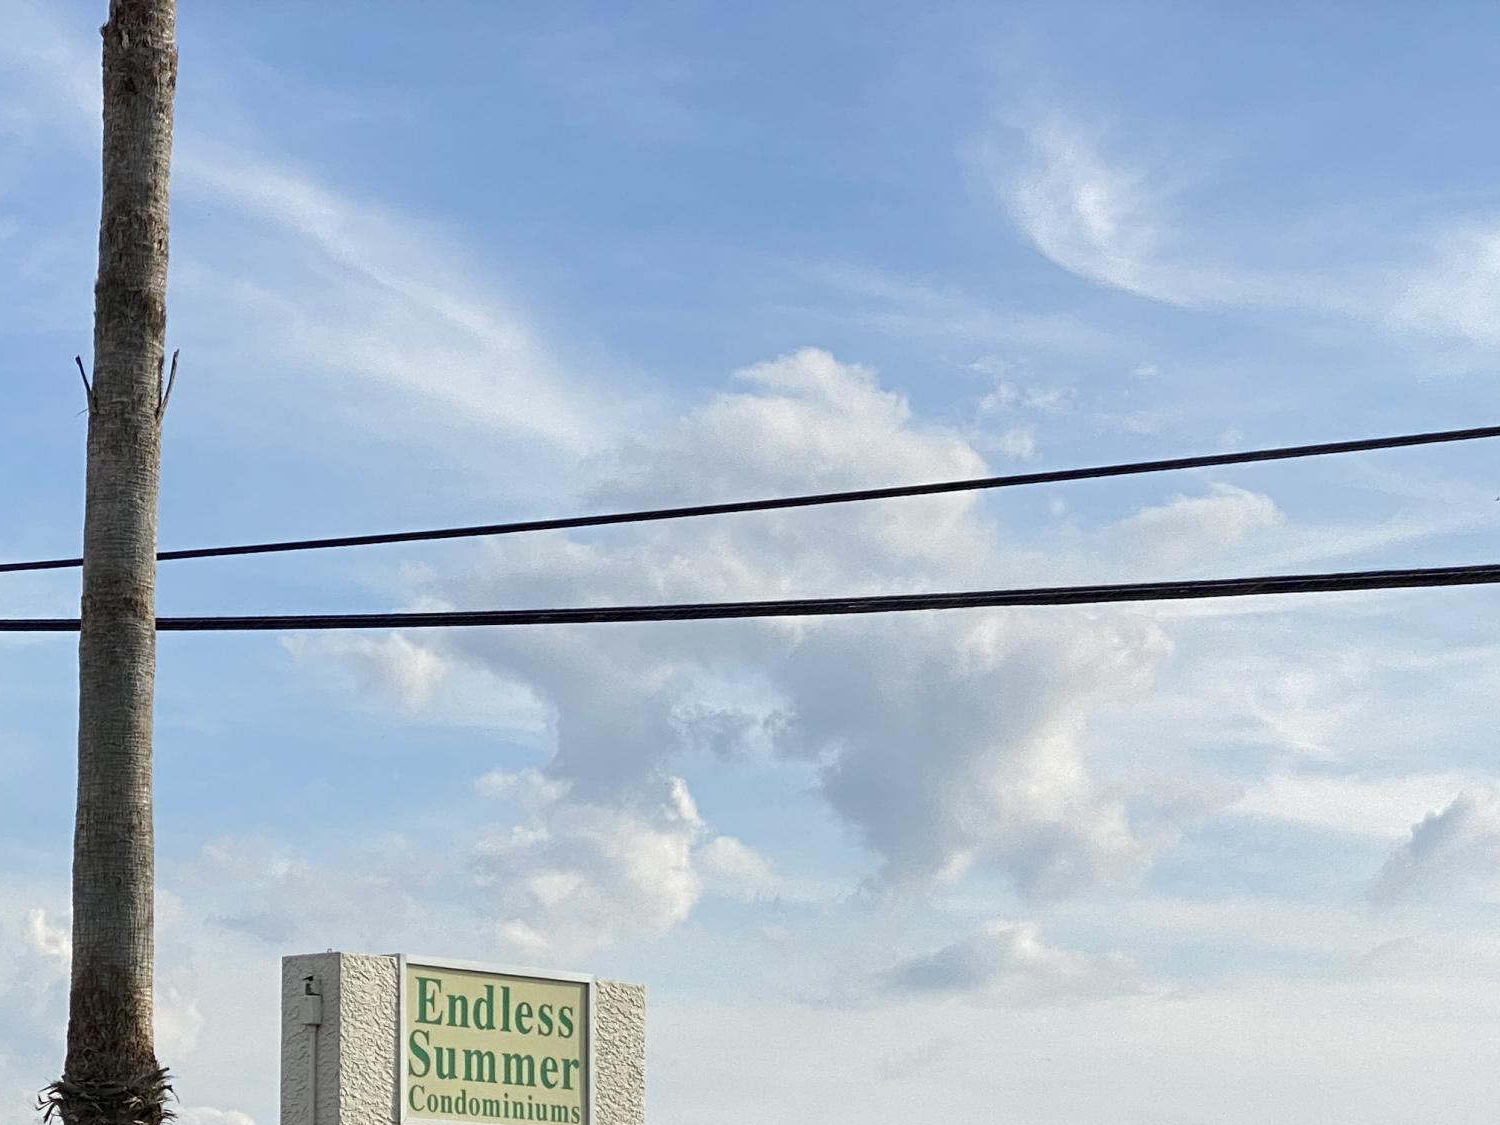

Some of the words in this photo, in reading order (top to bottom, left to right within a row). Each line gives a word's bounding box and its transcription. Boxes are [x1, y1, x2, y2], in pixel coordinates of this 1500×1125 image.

[414, 976, 574, 1038] Endless
[408, 1029, 580, 1091] Summer
[408, 1084, 580, 1124] Condominiums
